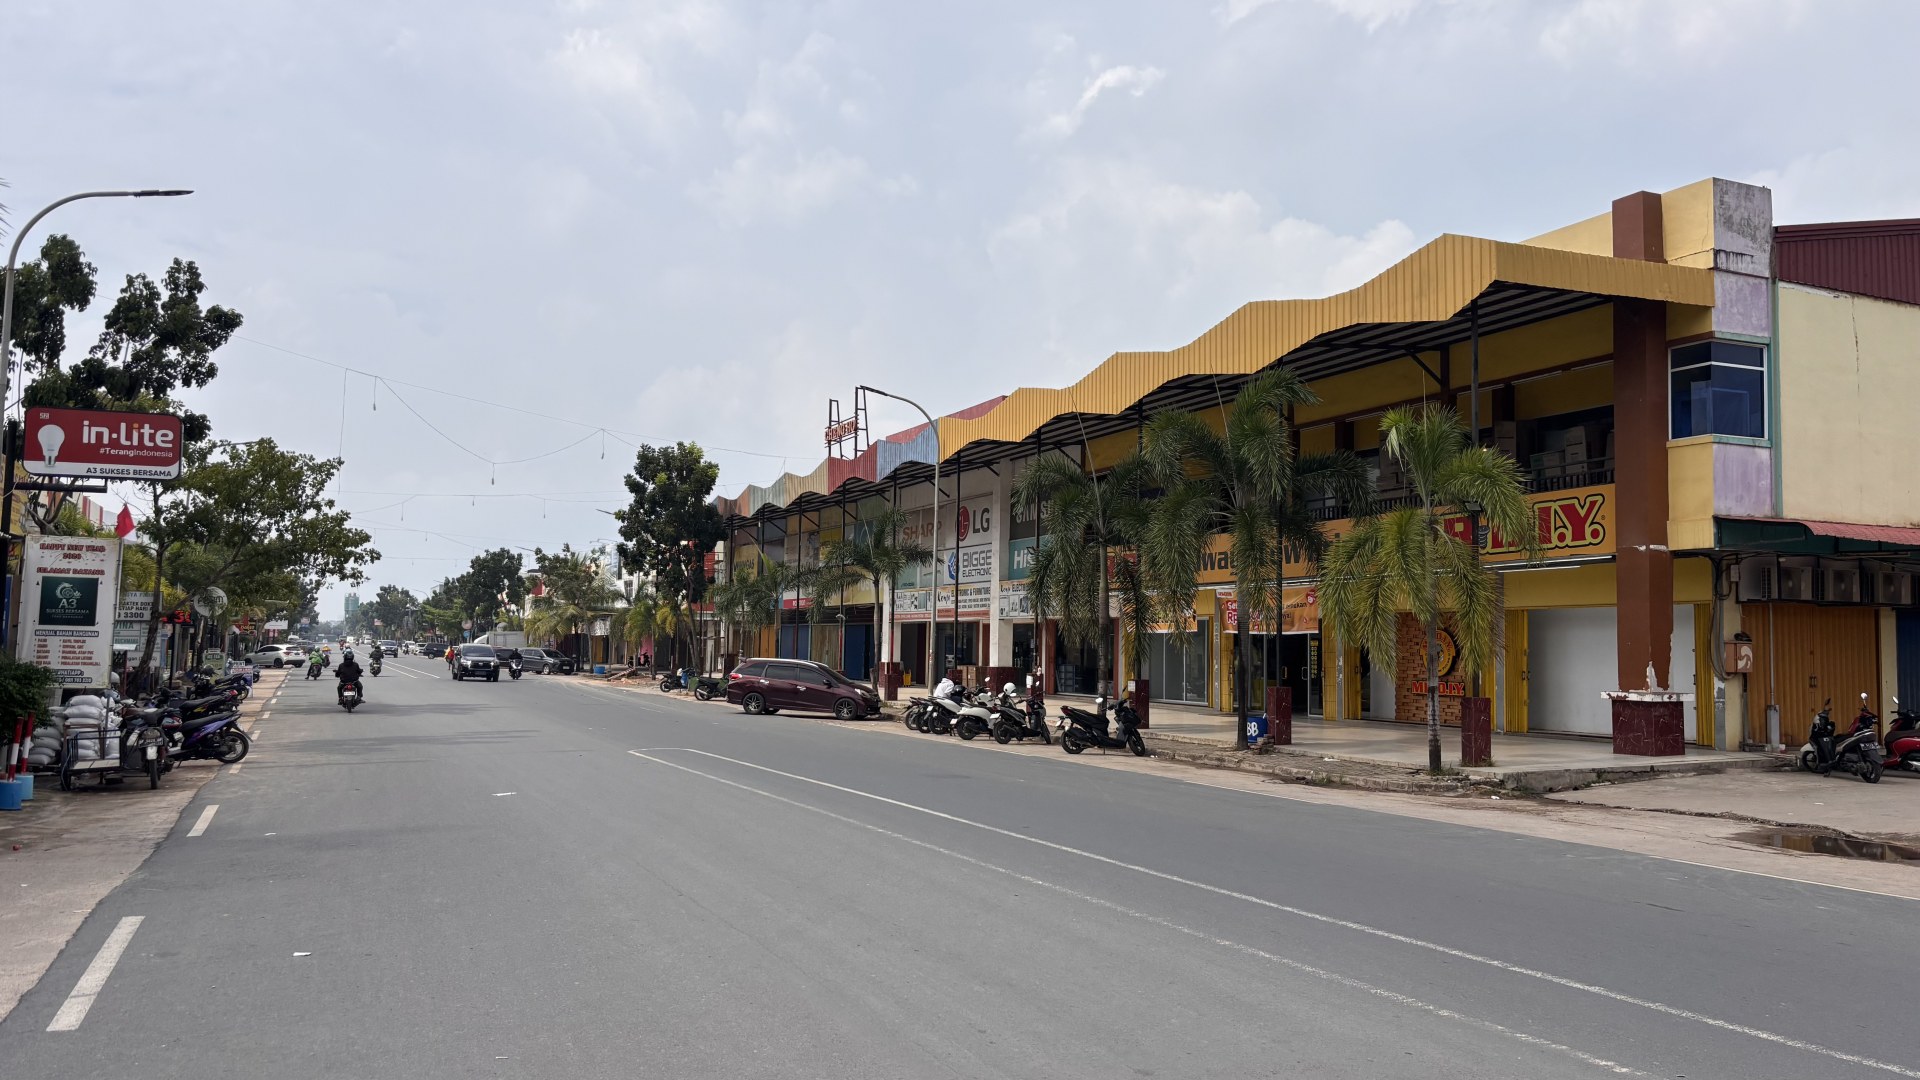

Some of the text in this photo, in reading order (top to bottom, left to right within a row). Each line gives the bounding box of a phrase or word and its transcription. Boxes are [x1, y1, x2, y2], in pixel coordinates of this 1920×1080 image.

[100, 447, 173, 458] #TerangIndonesia
[99, 468, 131, 476] SUKSES
[132, 469, 172, 477] BERSAMA
[972, 507, 990, 534] LG
[59, 598, 77, 609] A3
